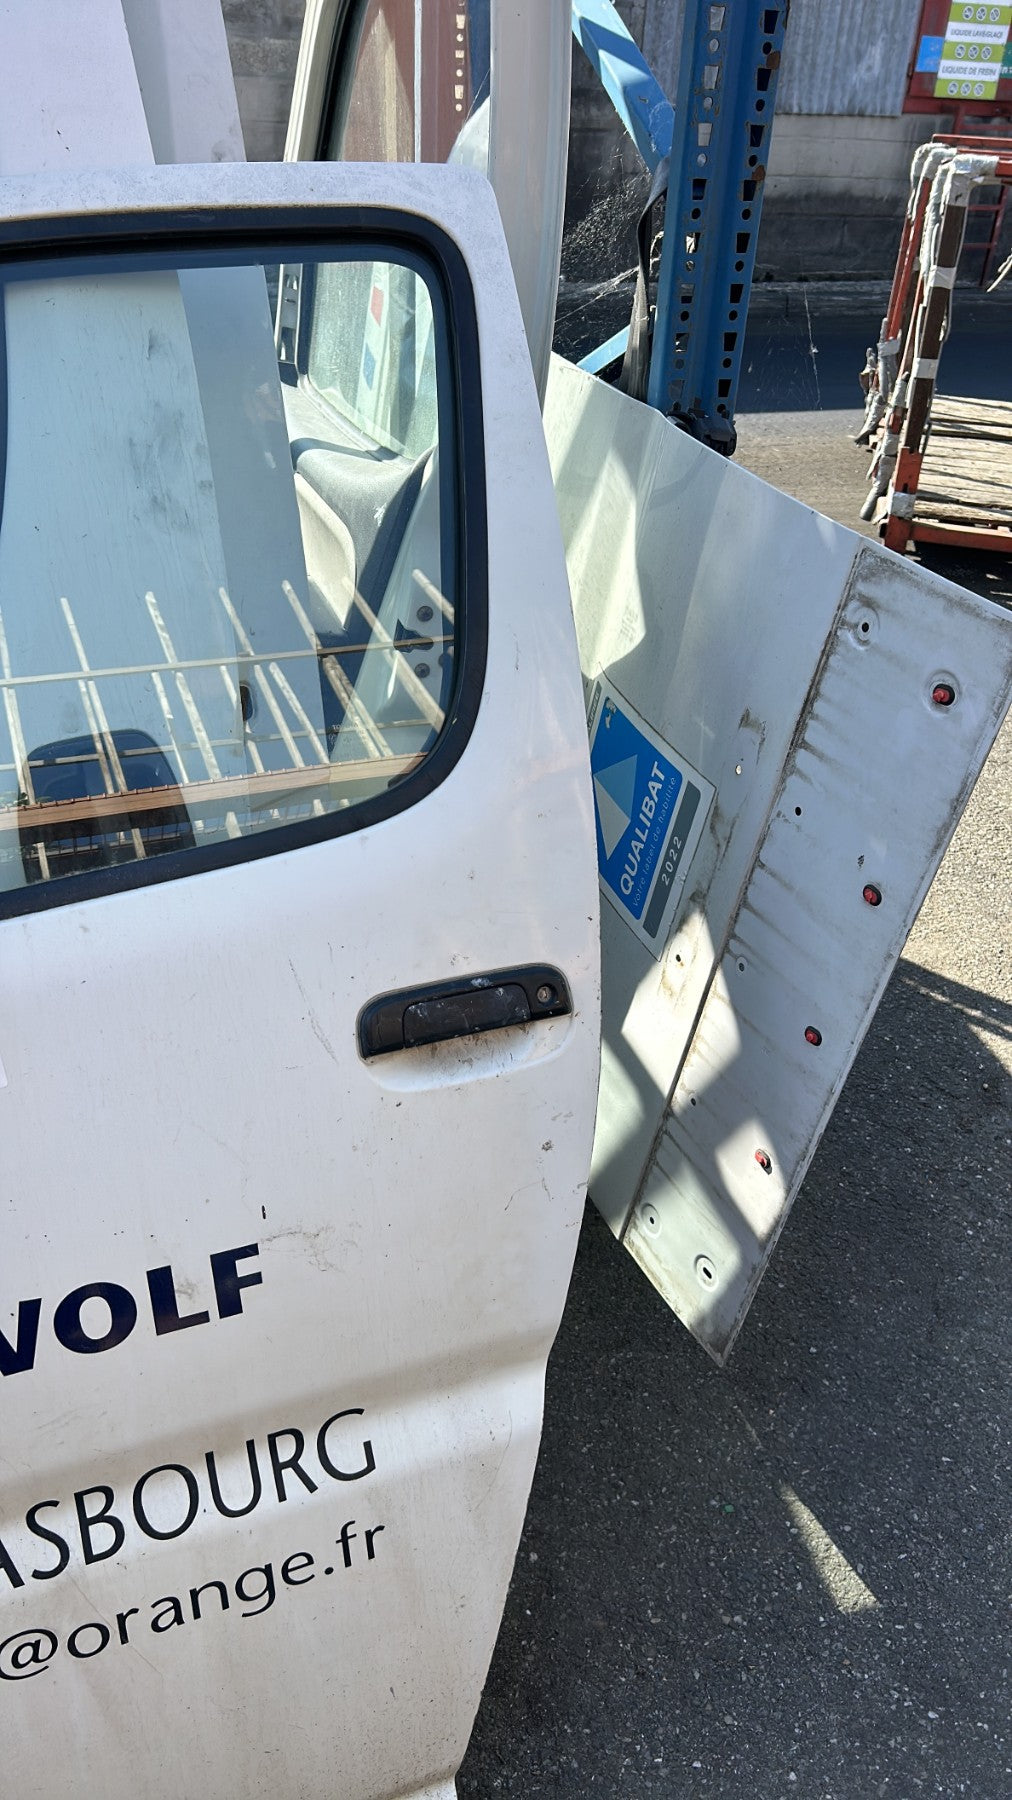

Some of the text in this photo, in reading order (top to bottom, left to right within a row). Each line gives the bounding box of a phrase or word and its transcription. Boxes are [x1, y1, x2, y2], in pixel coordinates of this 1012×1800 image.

[951, 29, 972, 37] LIQUIDE
[942, 66, 968, 75] LIQUIDE
[968, 67, 977, 76] DE
[620, 761, 667, 895] QUALIBAT
[642, 844, 656, 875] label
[653, 826, 661, 842] de
[661, 835, 683, 887] 2022
[0, 1520, 385, 1681] @orange.fr
